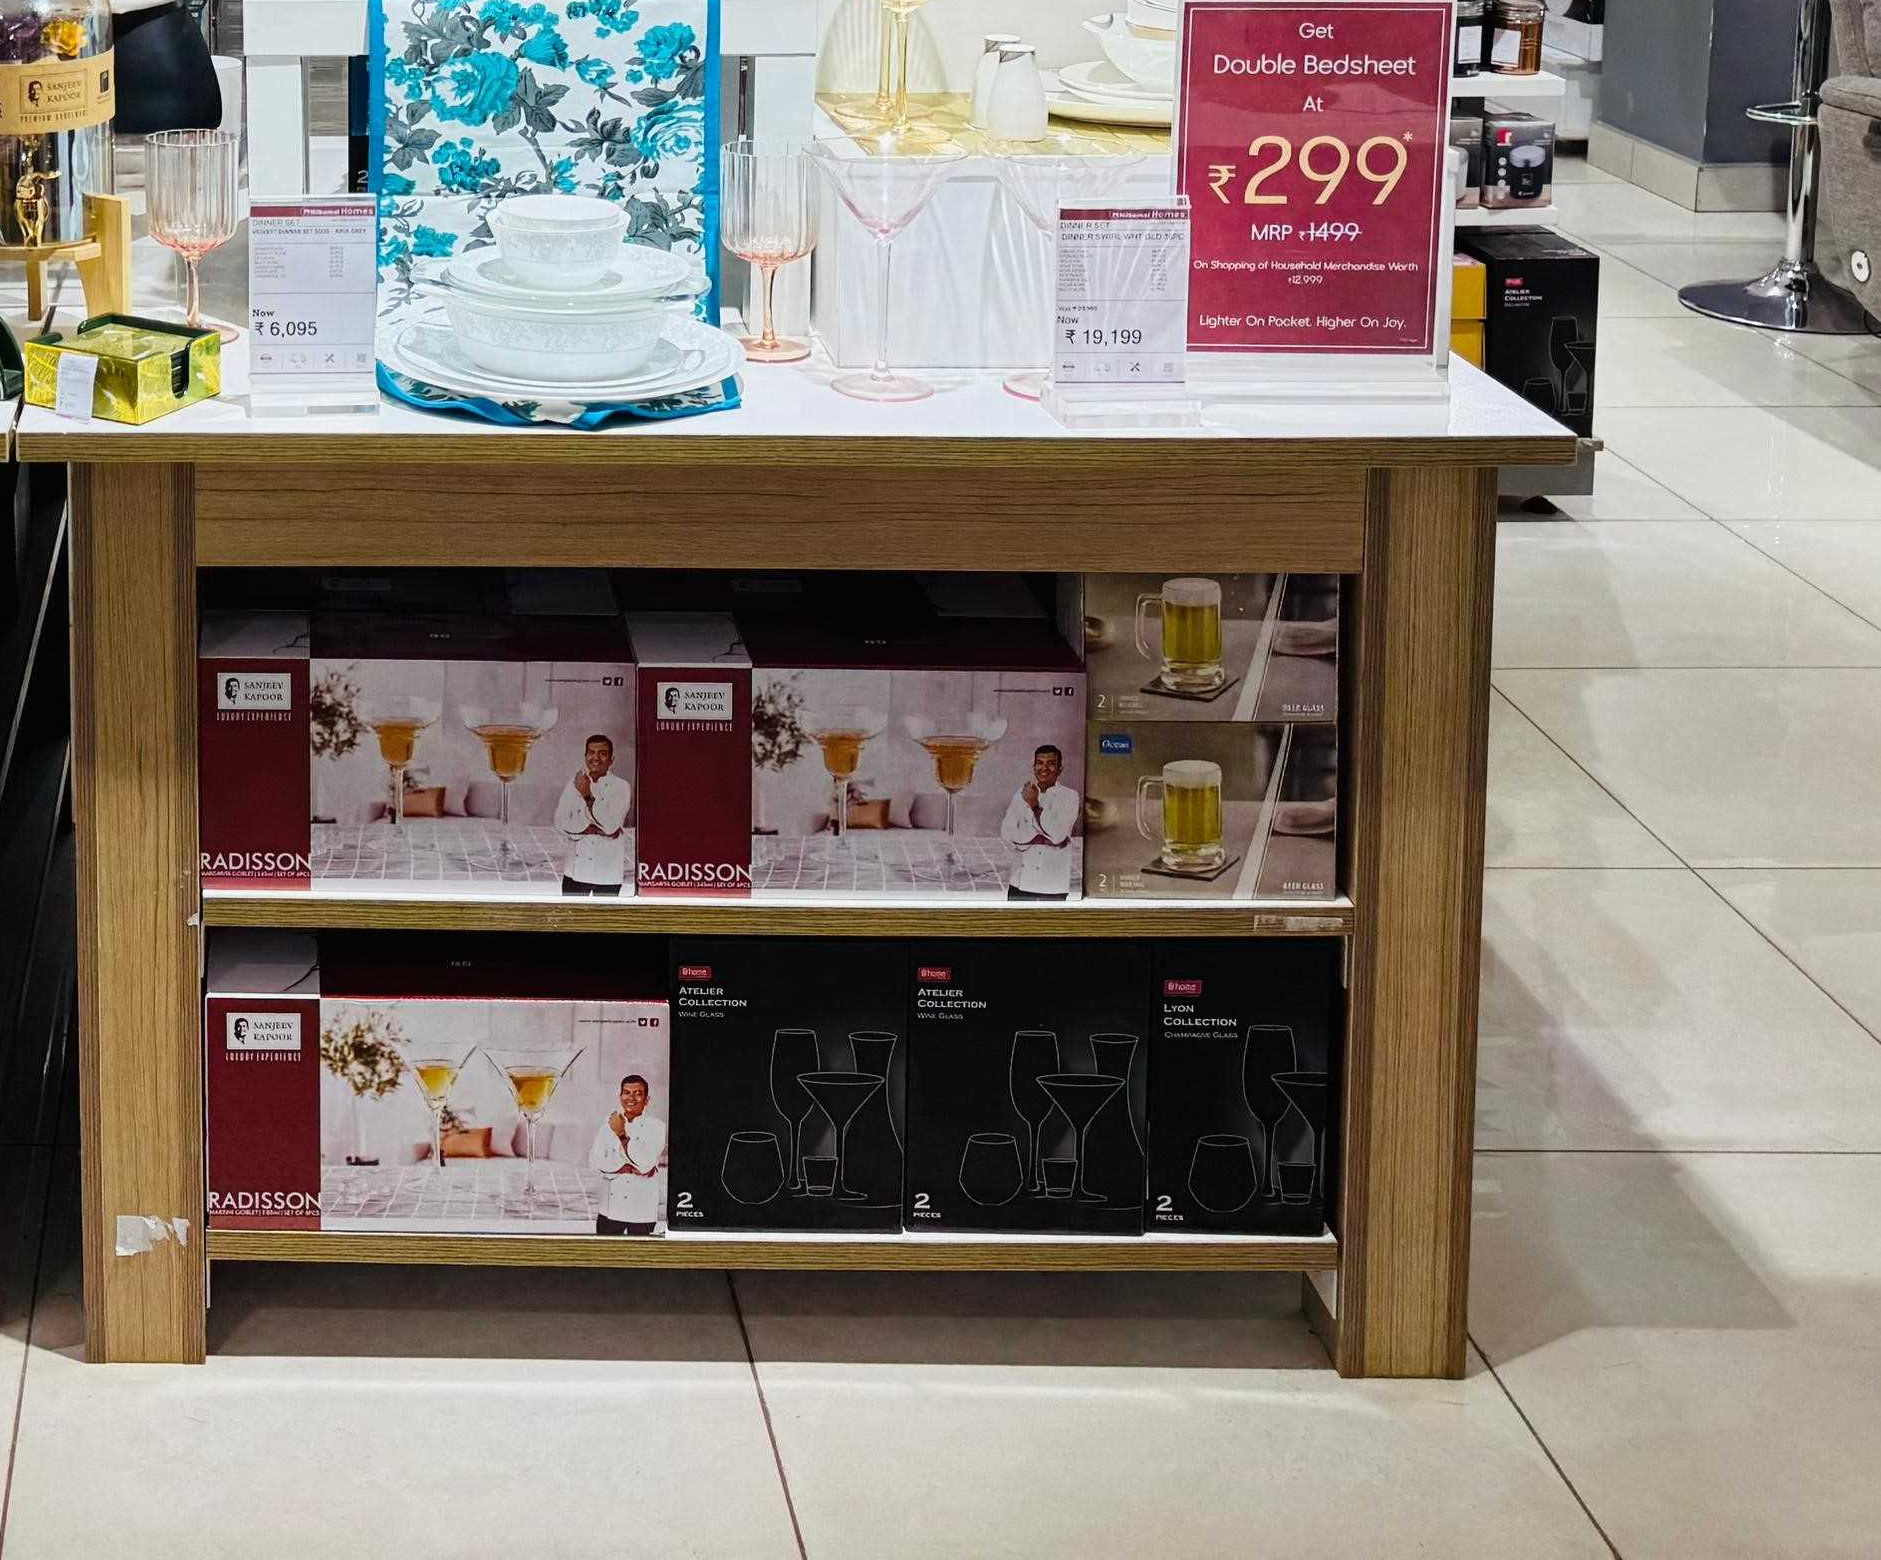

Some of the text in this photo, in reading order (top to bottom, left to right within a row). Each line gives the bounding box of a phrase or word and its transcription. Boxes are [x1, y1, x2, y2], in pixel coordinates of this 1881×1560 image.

[1298, 22, 1334, 40] Get
[1213, 53, 1416, 76] Double Bedsheet
[1302, 96, 1324, 112] At
[340, 207, 374, 215] Homes
[1151, 210, 1186, 218] Homes
[1250, 223, 1293, 241] MRP
[1193, 260, 1419, 273] On Shopping of Household Merchandise Worth
[252, 308, 275, 317] Now
[1056, 315, 1079, 324] Now
[1199, 314, 1242, 328] Lighter
[1245, 315, 1265, 327] On
[1316, 316, 1357, 330] Higher
[1360, 317, 1379, 329] On
[1382, 317, 1407, 330] Joy.
[254, 321, 318, 338] ₹ 6,095
[1065, 329, 1142, 346] ₹ 19,199
[244, 681, 284, 691] SANJEEV
[684, 690, 725, 701] SANJEEV
[1097, 695, 1106, 708] 2
[684, 702, 725, 712] KAPOOR
[200, 852, 311, 871] RADISSON
[638, 862, 752, 882] RADISSON
[1098, 873, 1107, 887] 2
[678, 986, 724, 995] ATELIER
[917, 988, 963, 997] ATELIER
[678, 998, 747, 1007] COLLECTION
[917, 1000, 987, 1009] COLLECTION
[1163, 1003, 1194, 1014] LYON
[253, 1020, 293, 1031] SANJEEV
[1163, 1017, 1238, 1027] COLLECTION
[253, 1032, 293, 1042] KAPOOR
[209, 1191, 321, 1210] RADISSON
[677, 1192, 694, 1208] 2
[914, 1193, 931, 1209] 2
[1156, 1195, 1173, 1212] 2
